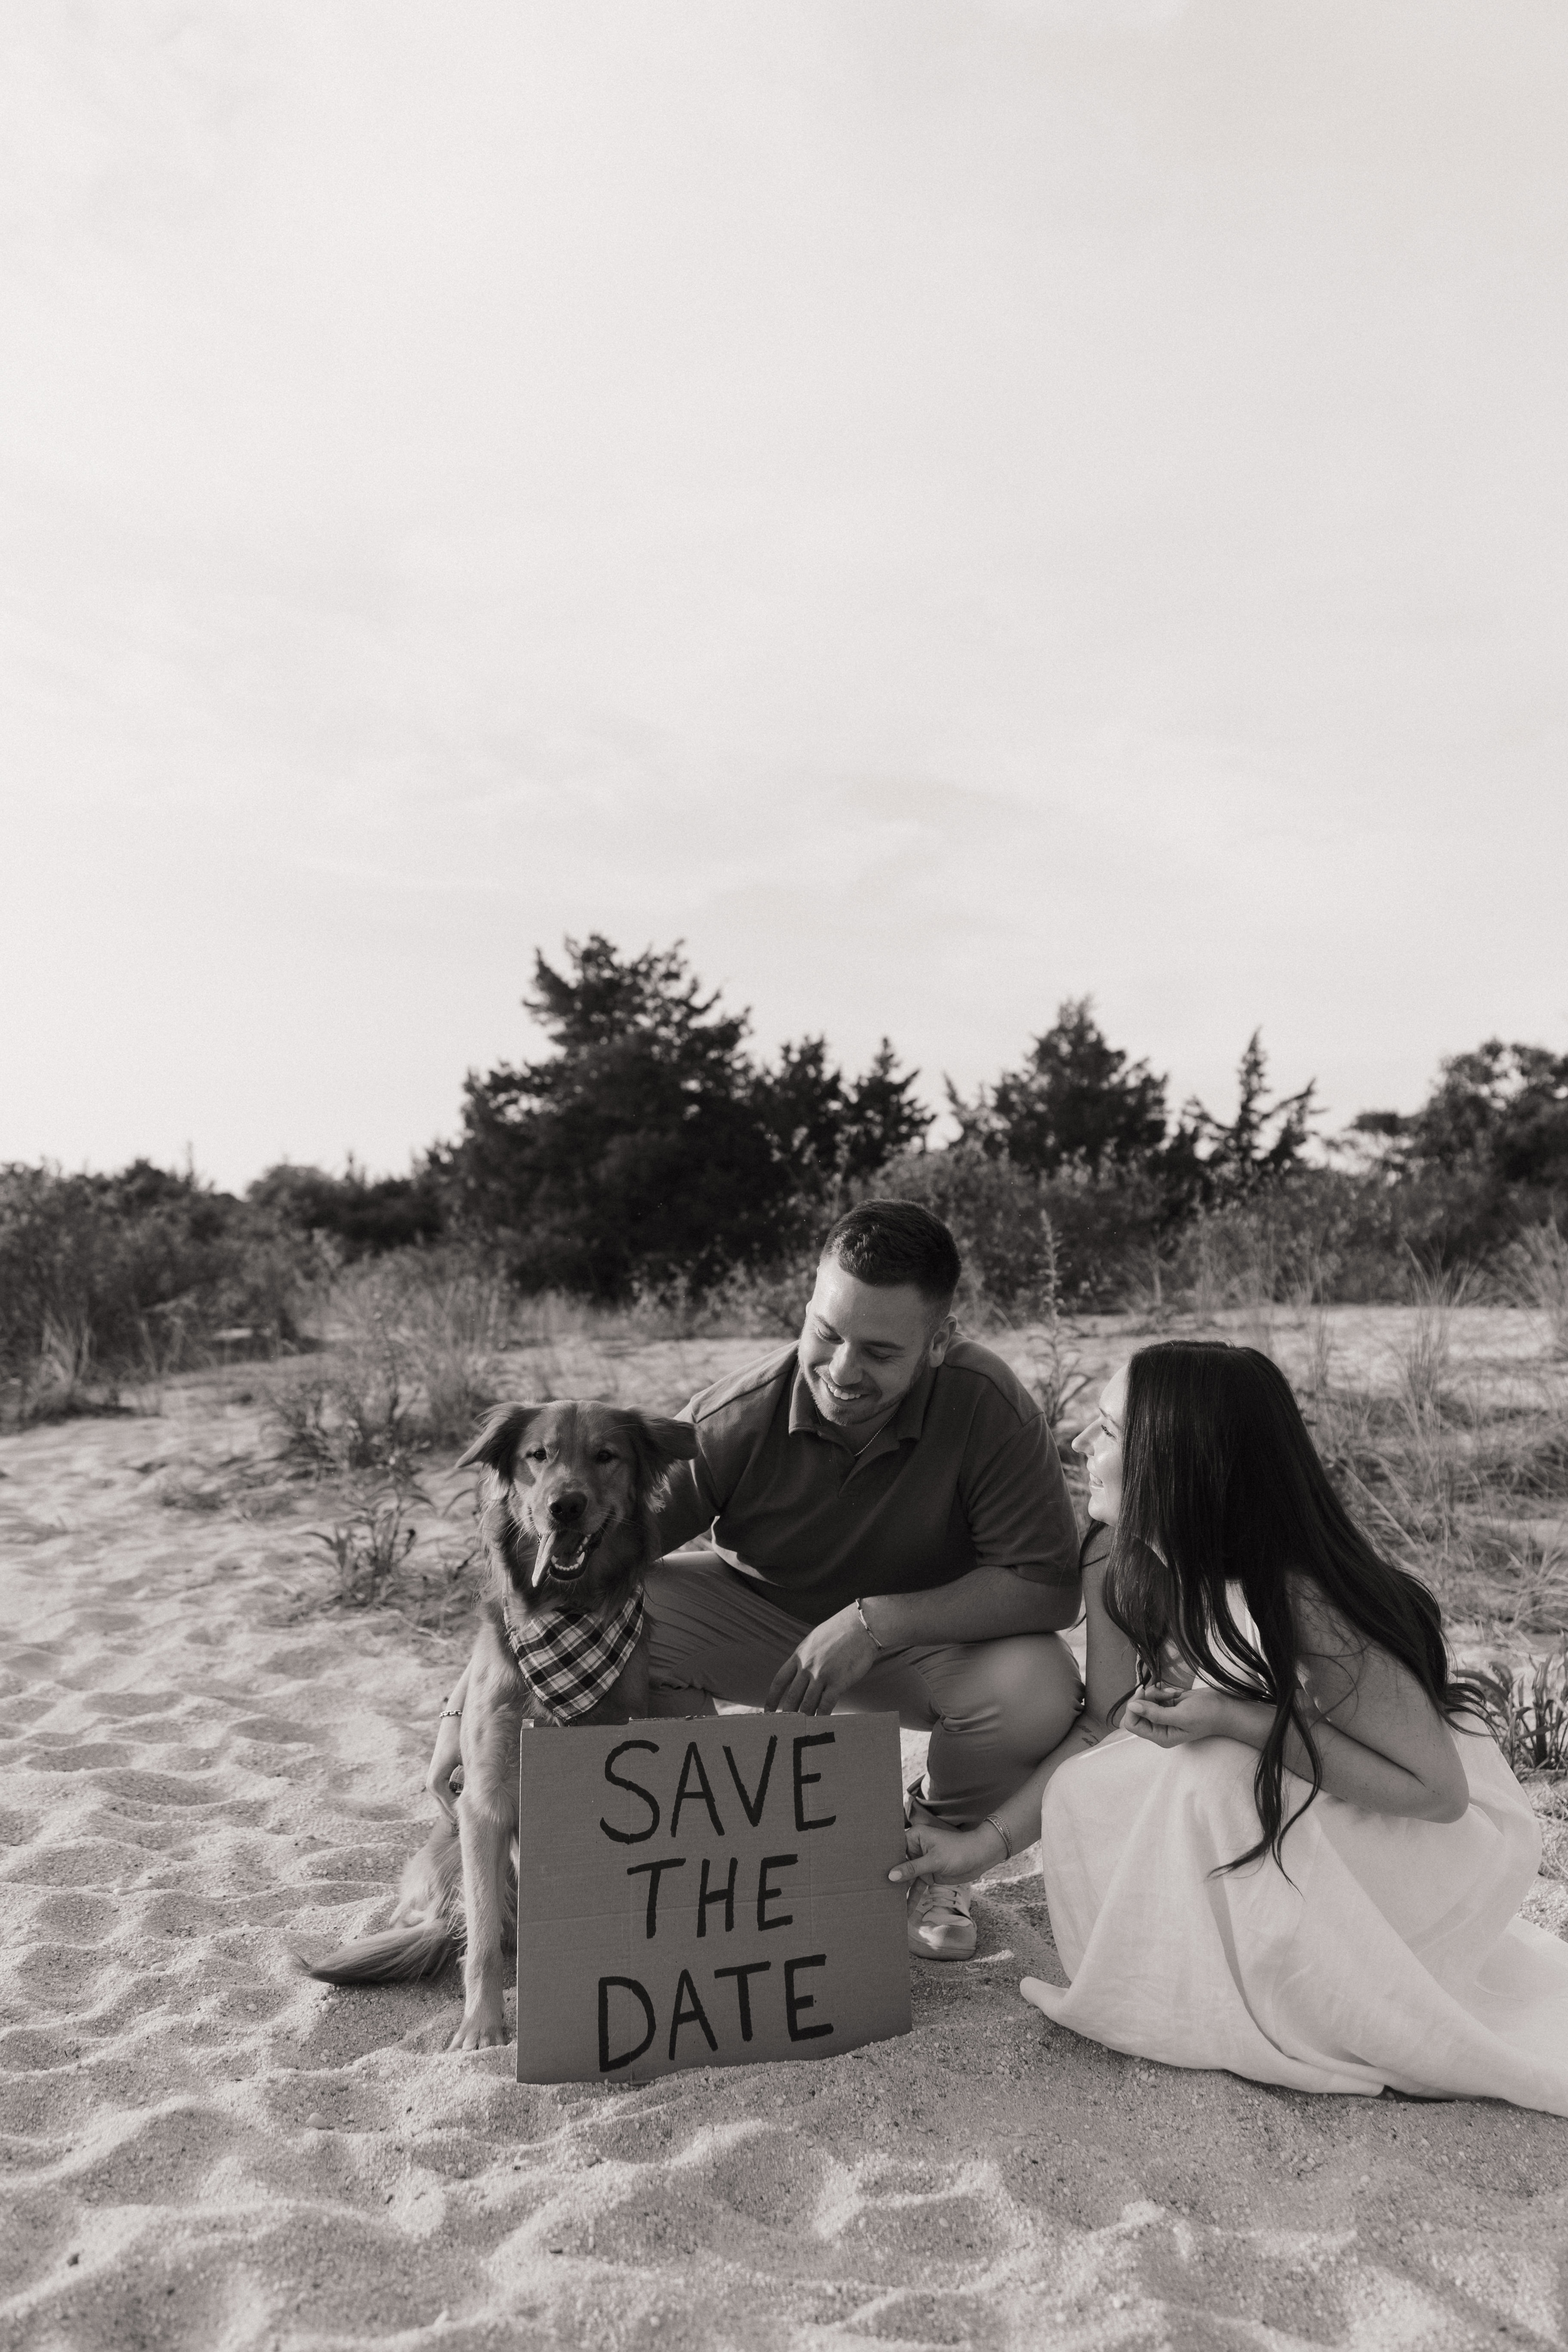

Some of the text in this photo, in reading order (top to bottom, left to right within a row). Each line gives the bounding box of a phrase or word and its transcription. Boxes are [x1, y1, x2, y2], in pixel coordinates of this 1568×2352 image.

[600, 1731, 836, 1845] SAVE
[627, 1854, 799, 1939] THE
[598, 1954, 834, 2073] DATE
